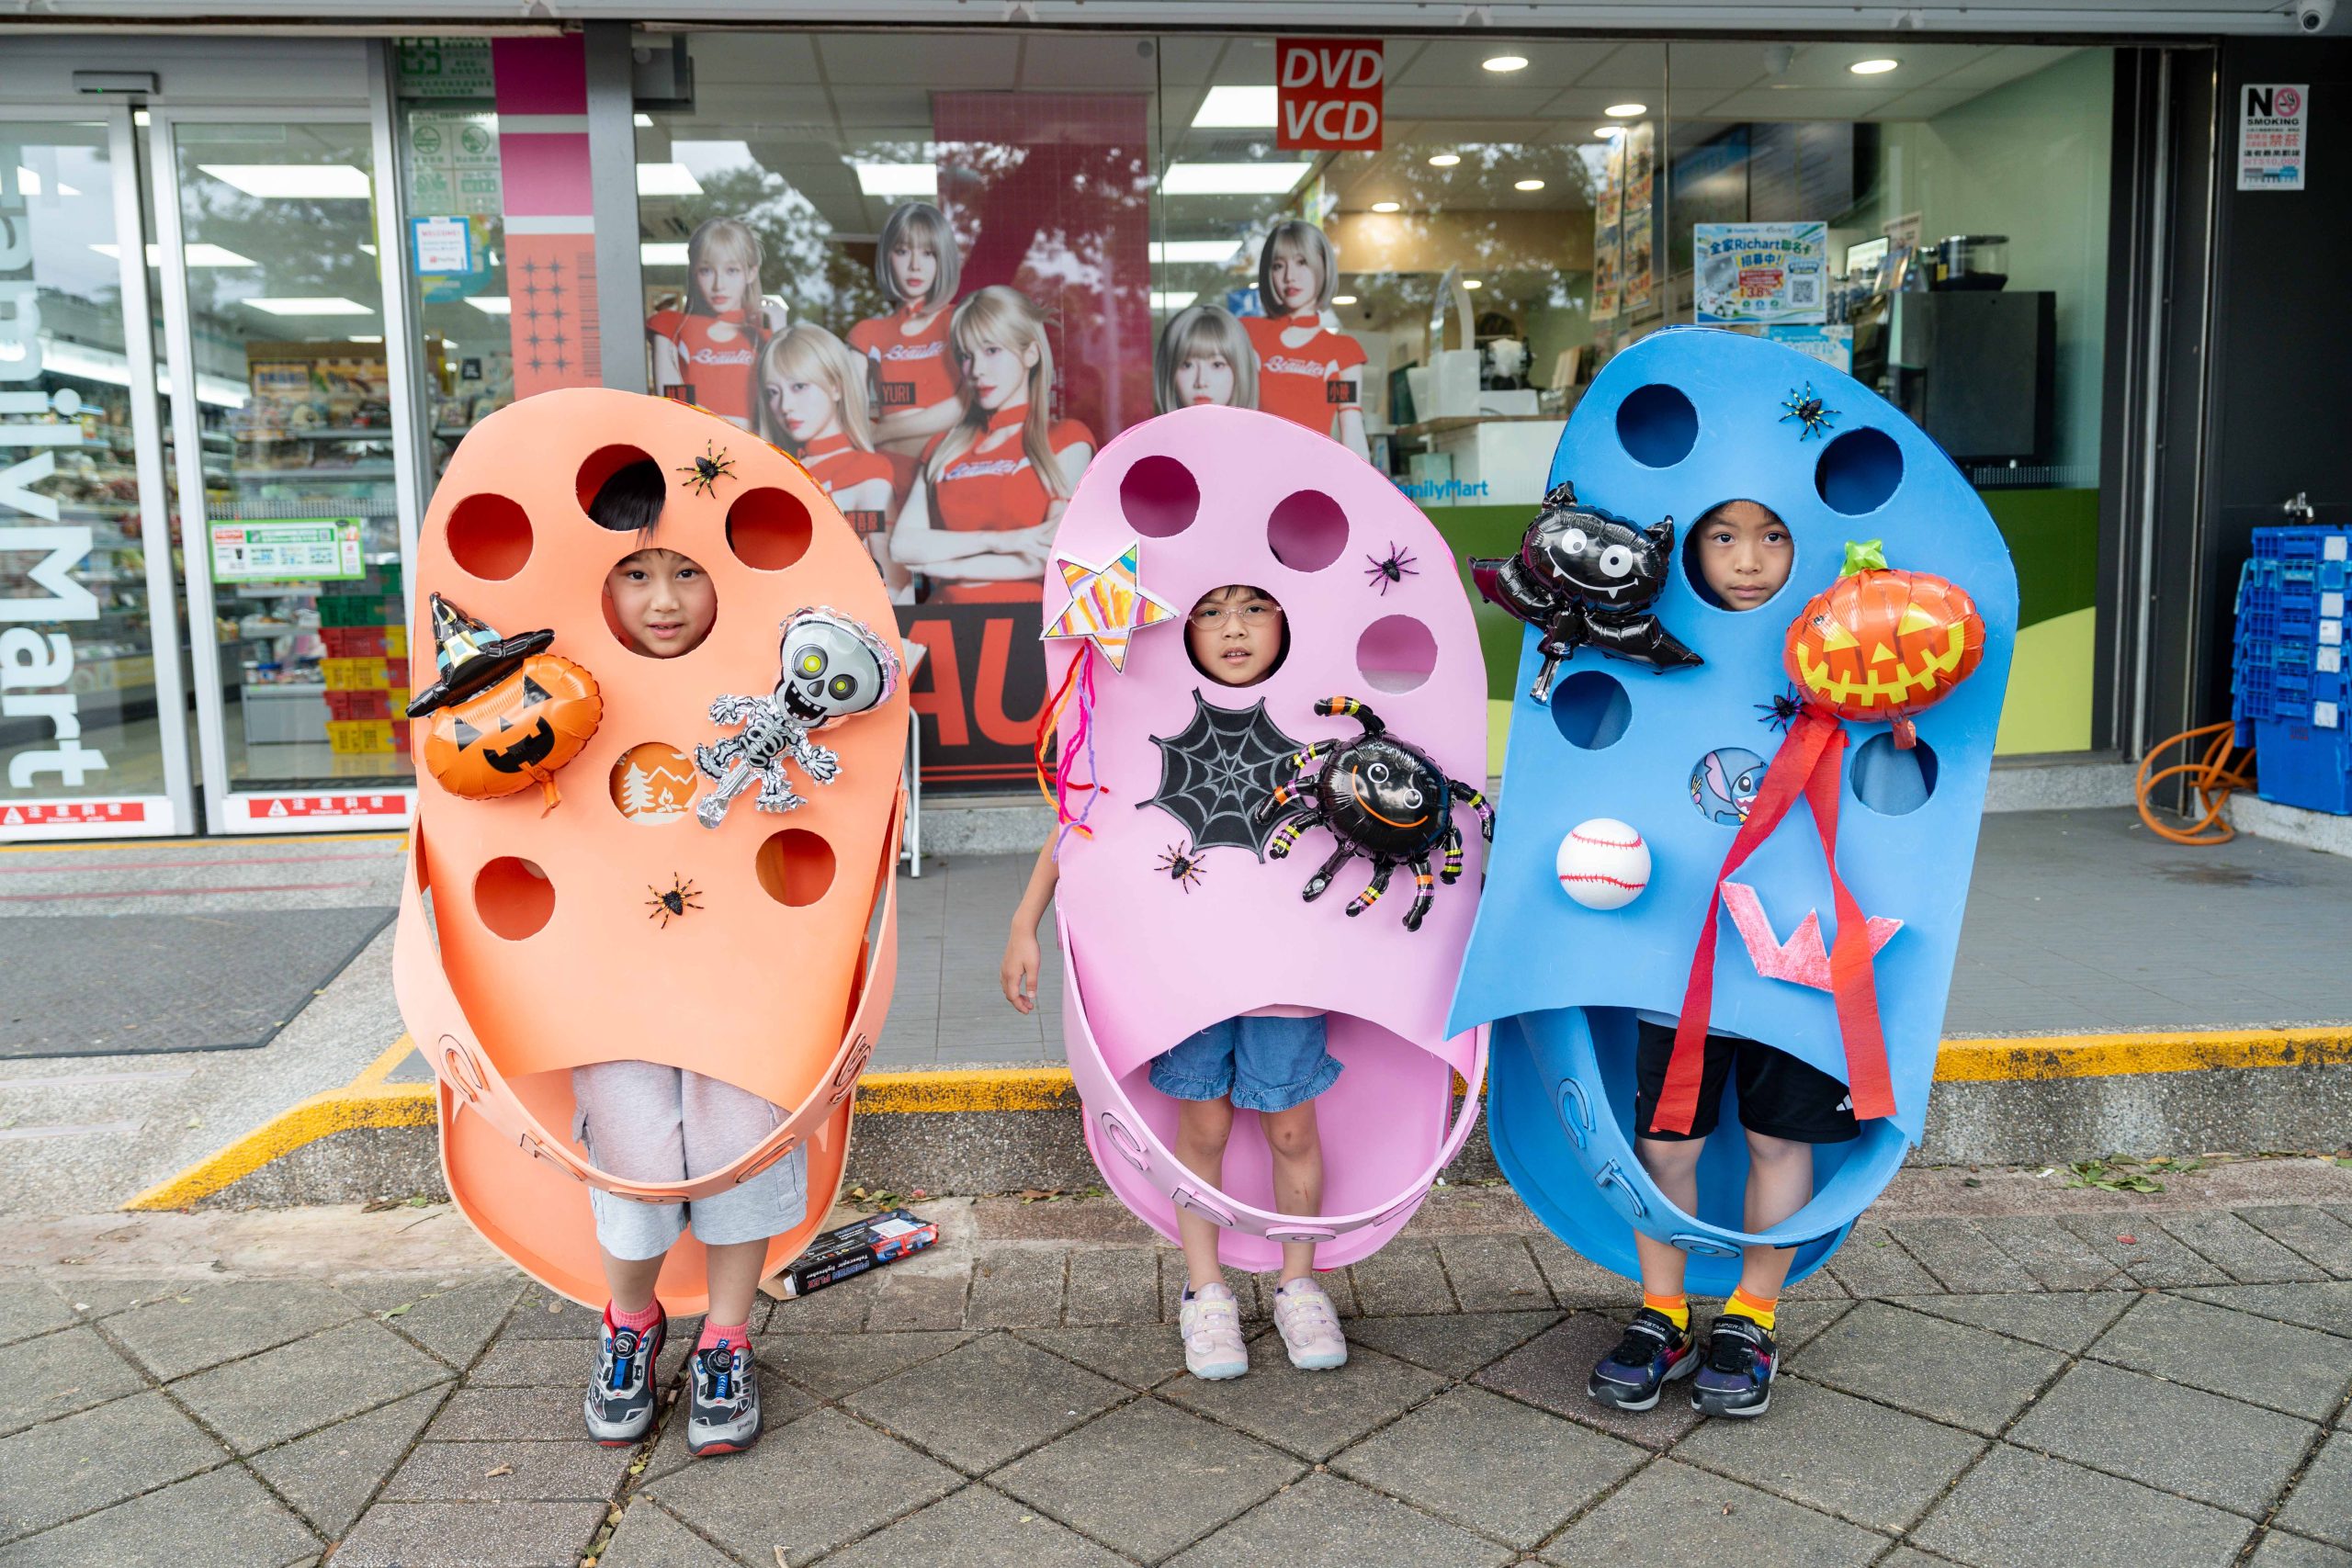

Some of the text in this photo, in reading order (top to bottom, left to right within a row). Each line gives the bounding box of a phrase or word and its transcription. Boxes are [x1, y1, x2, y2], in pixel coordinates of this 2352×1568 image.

[1282, 48, 1383, 89] DVD
[1284, 100, 1378, 141] VCD
[2247, 118, 2301, 126] SMOKING
[882, 385, 910, 403] YURI
